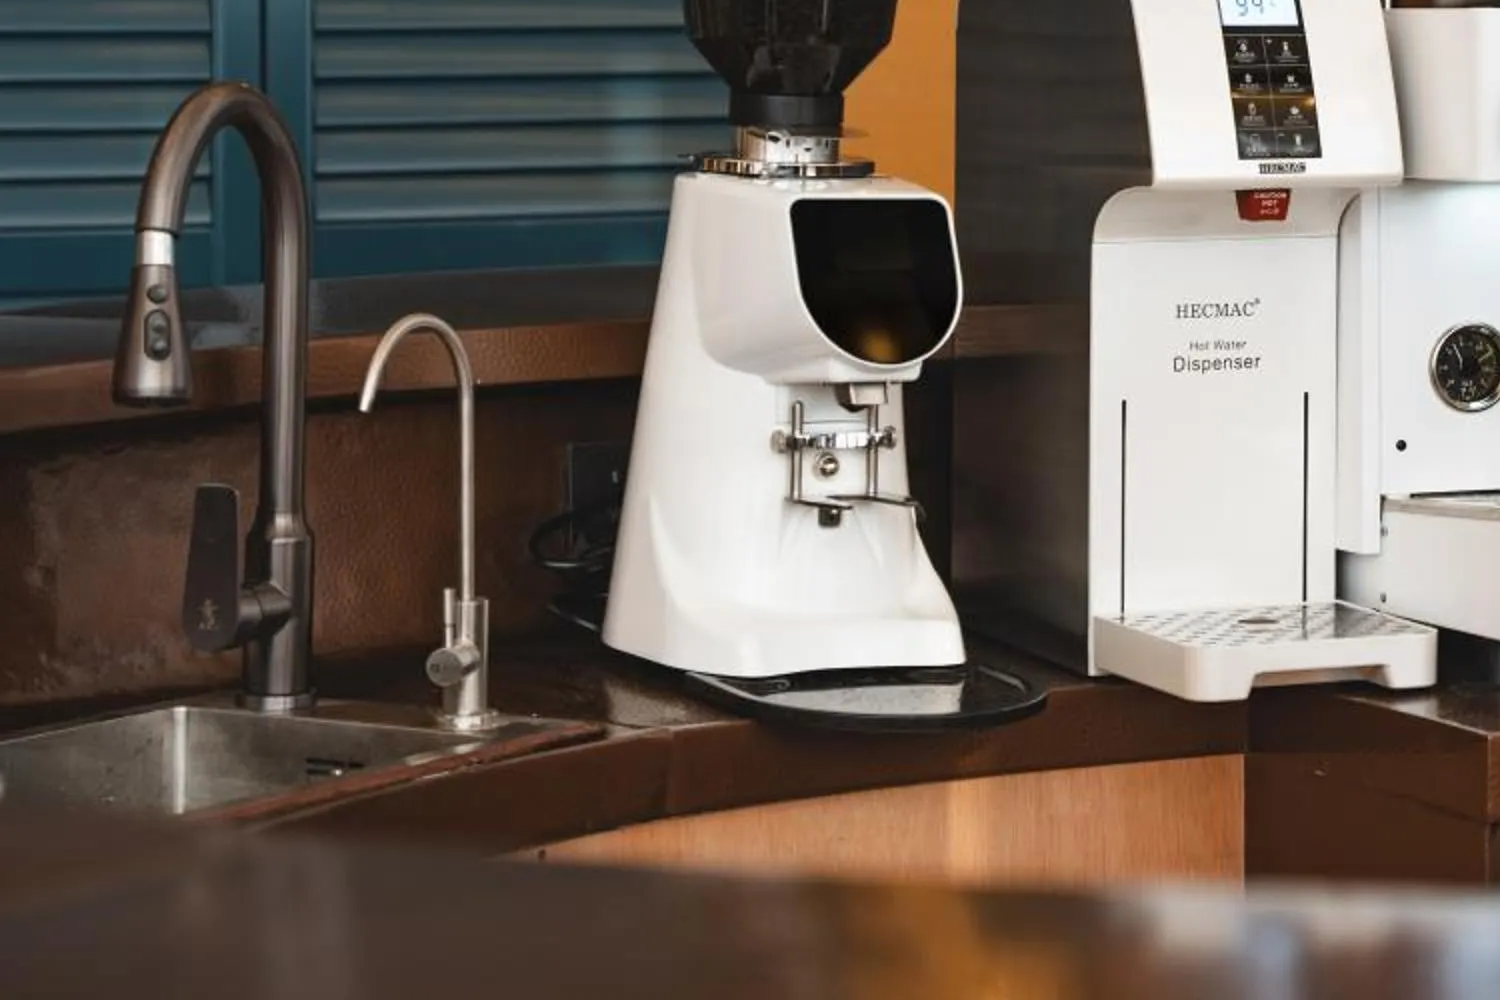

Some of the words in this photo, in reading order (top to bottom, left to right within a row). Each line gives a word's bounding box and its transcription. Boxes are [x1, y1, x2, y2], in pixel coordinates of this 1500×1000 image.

[1189, 340, 1209, 351] Hot
[1214, 339, 1247, 351] Water
[1173, 355, 1261, 375] Dispenser
